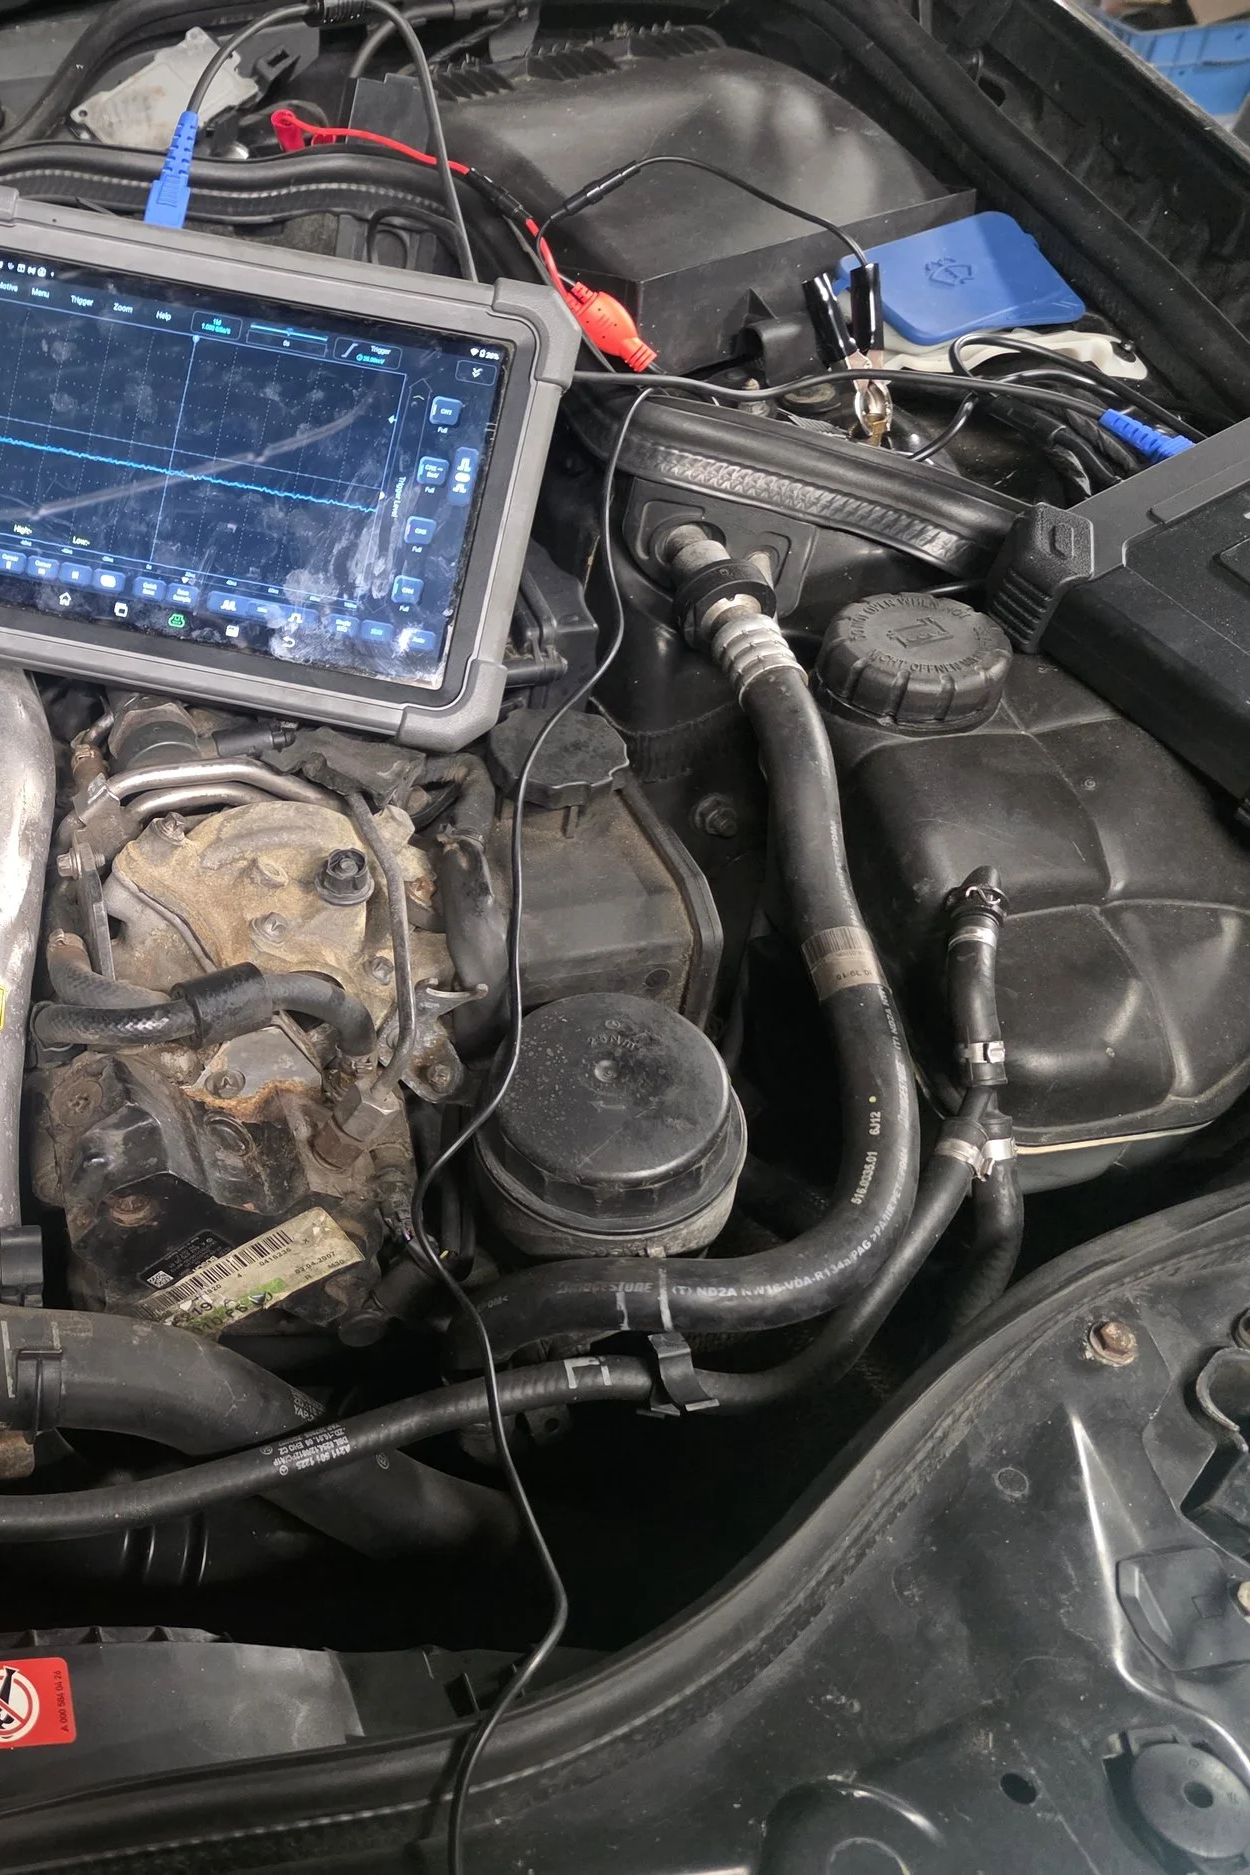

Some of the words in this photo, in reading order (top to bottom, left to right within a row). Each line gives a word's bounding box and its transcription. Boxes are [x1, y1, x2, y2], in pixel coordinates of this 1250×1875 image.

[31, 287, 50, 299] Menu
[70, 294, 94, 308] Trigger
[113, 302, 134, 314] Zoom
[155, 310, 172, 322] Help
[370, 345, 391, 356] Trigger
[437, 426, 449, 434] Full
[395, 475, 407, 502] Trigger
[424, 486, 435, 494] Full
[390, 501, 401, 518] Level
[411, 545, 423, 554] Full
[399, 604, 410, 613] Full
[868, 1110, 882, 1136] 6J12
[294, 1250, 336, 1275] 03.04.2007
[696, 1286, 738, 1297] ND2A
[57, 1708, 68, 1724] 000
